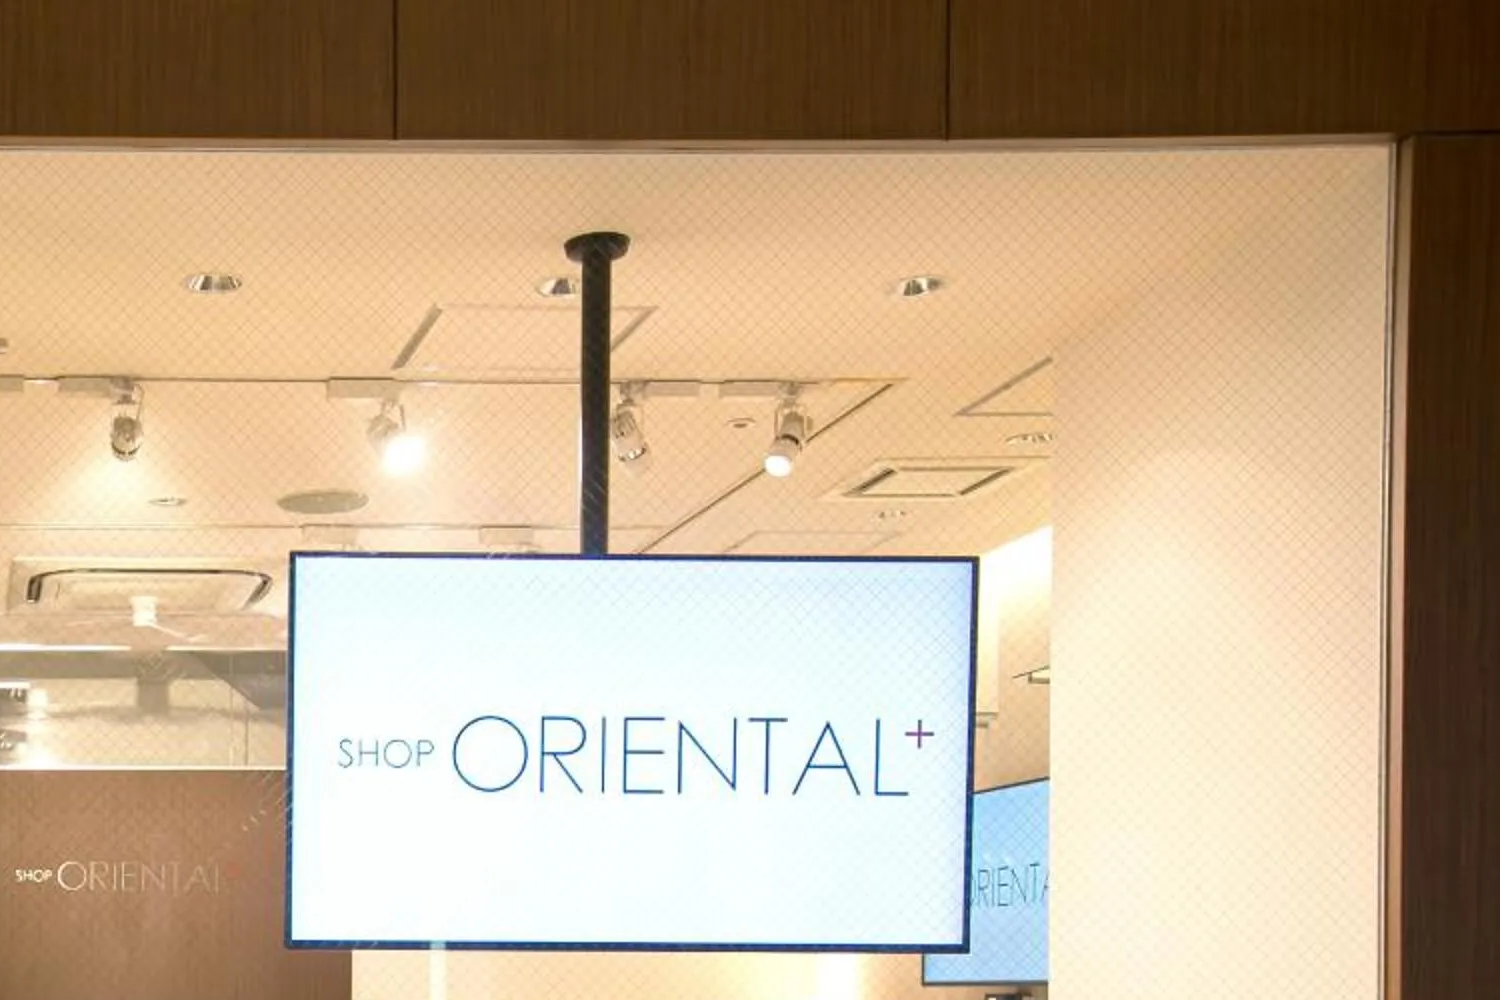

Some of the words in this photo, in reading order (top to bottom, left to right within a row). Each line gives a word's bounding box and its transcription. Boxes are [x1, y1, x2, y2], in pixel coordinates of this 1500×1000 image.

[338, 738, 435, 768] SHOP
[14, 868, 53, 884] SHOP
[971, 862, 1049, 908] RIENT
